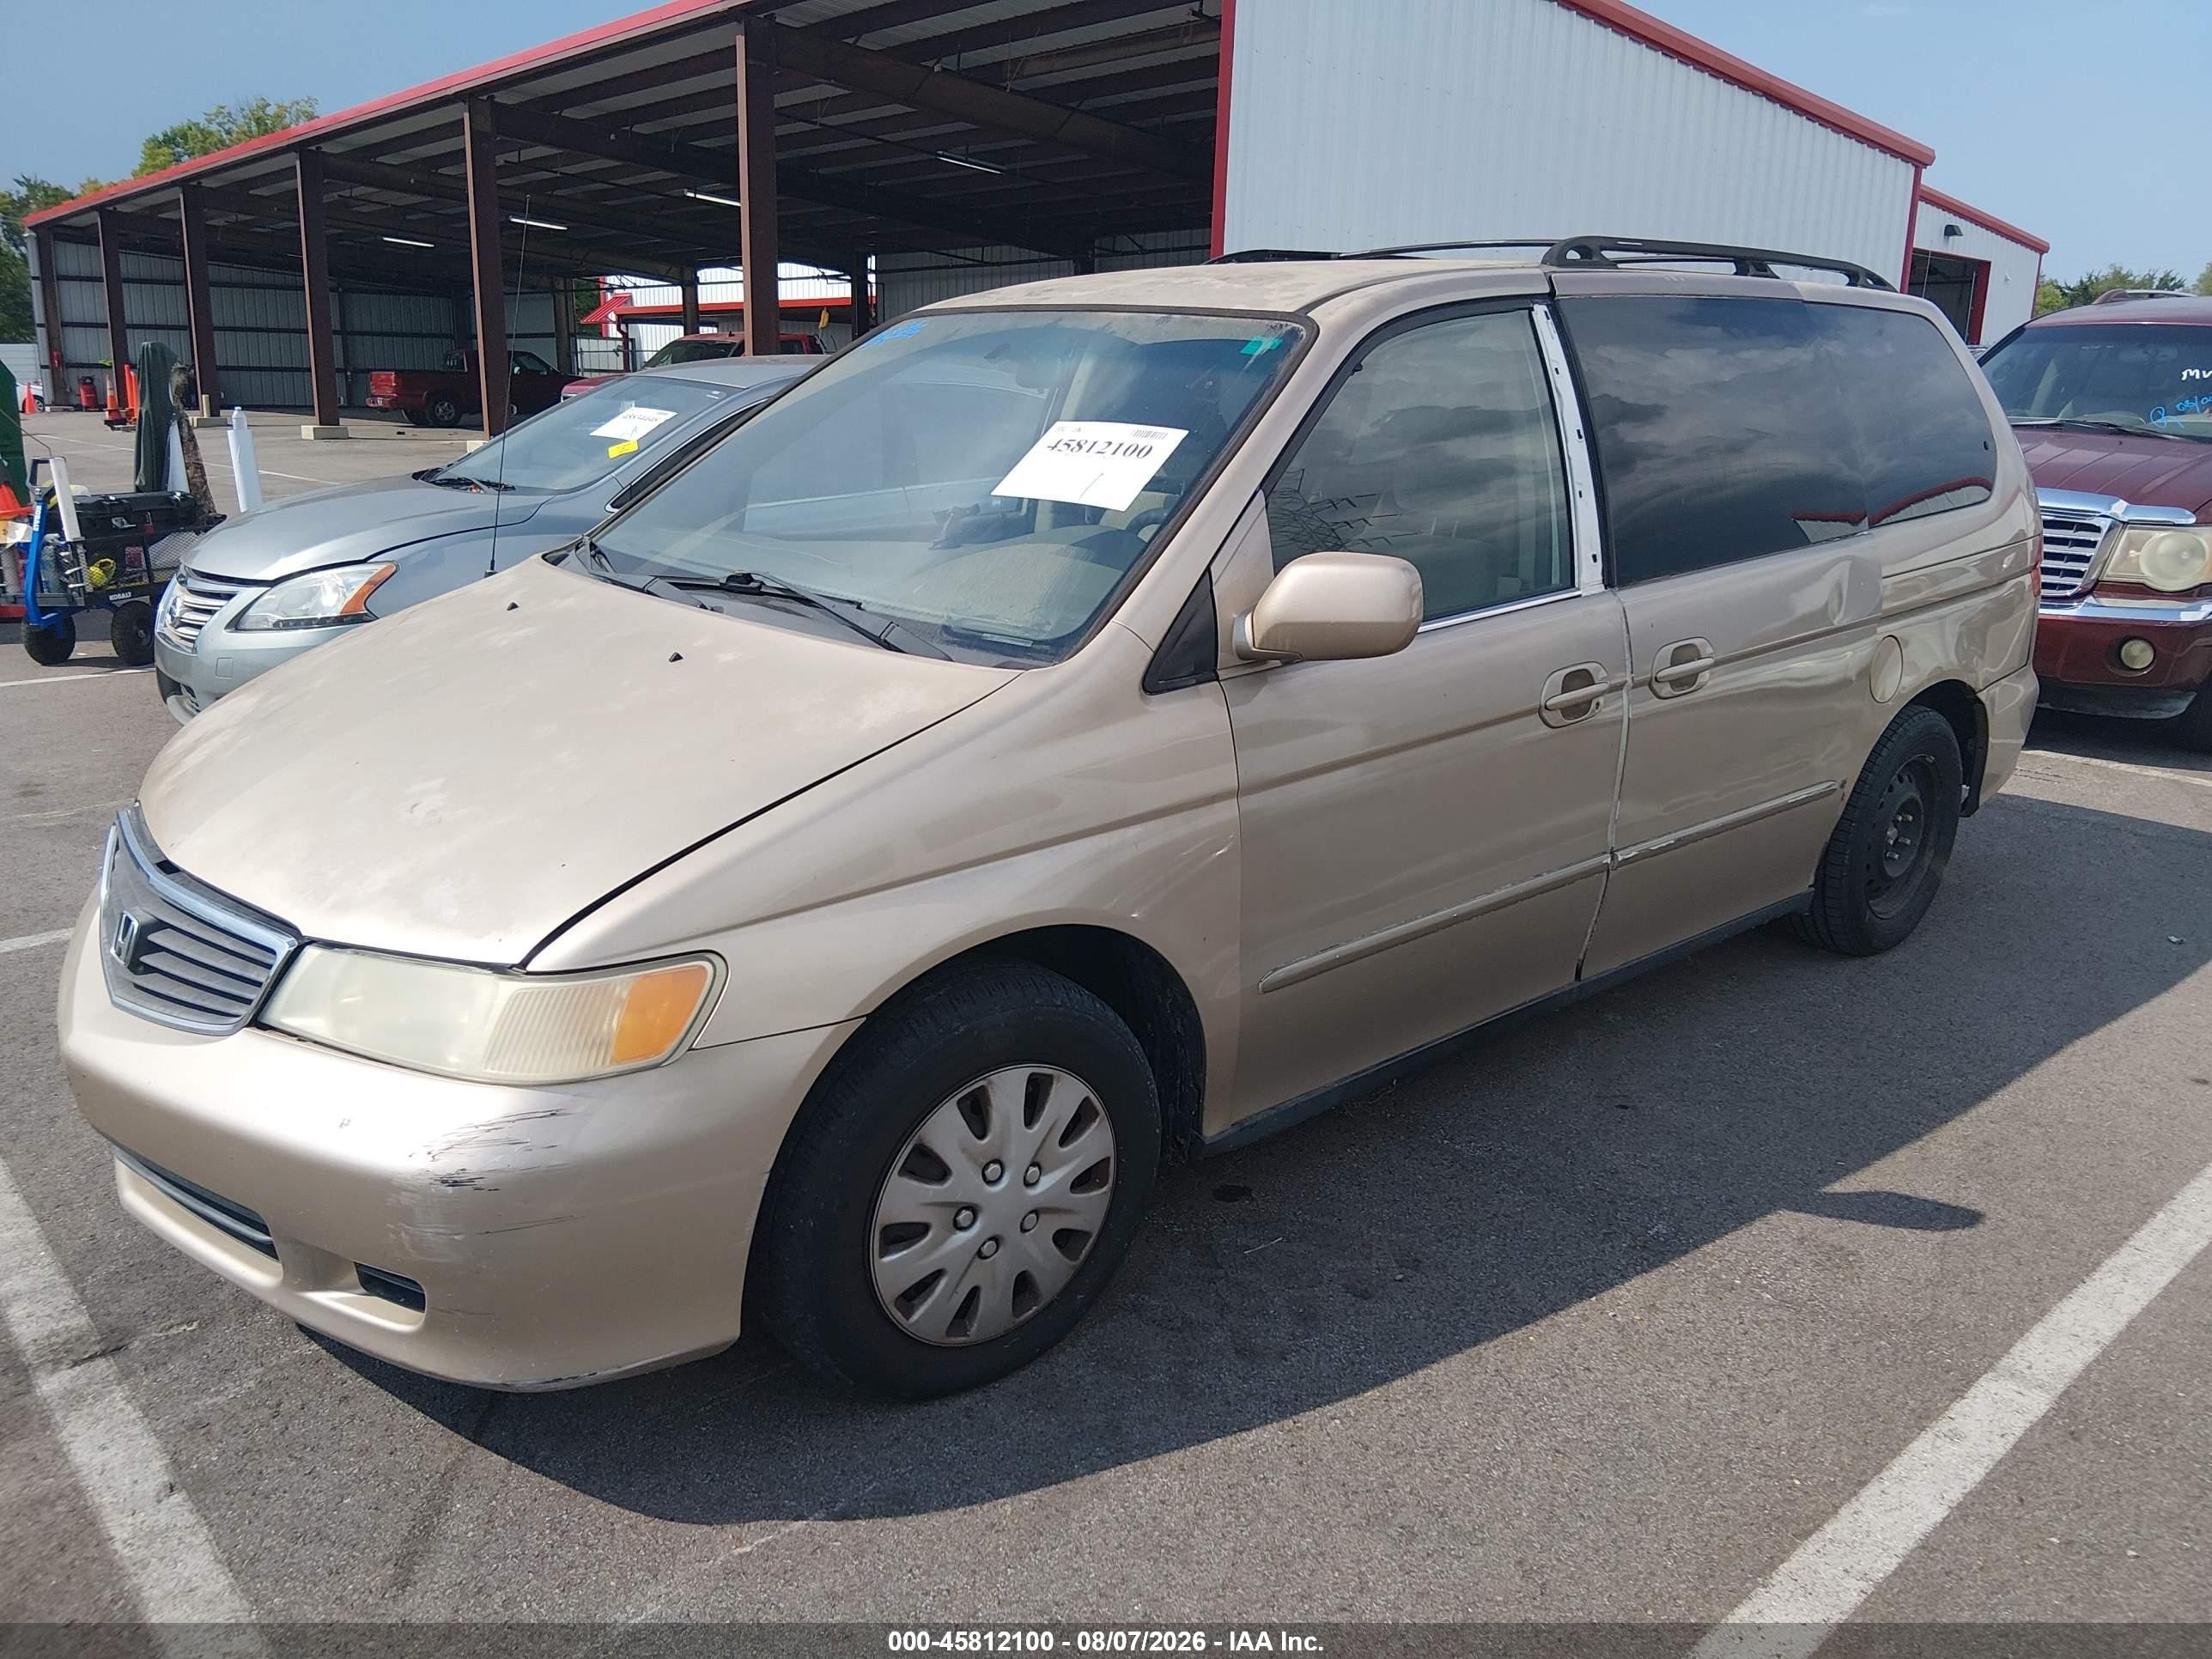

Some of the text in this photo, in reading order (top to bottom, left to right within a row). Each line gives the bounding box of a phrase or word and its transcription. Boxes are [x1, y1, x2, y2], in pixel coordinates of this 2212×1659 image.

[1047, 438, 1153, 459] 45812100
[33, 505, 43, 532] KOBALT
[108, 592, 132, 601] KOBALT
